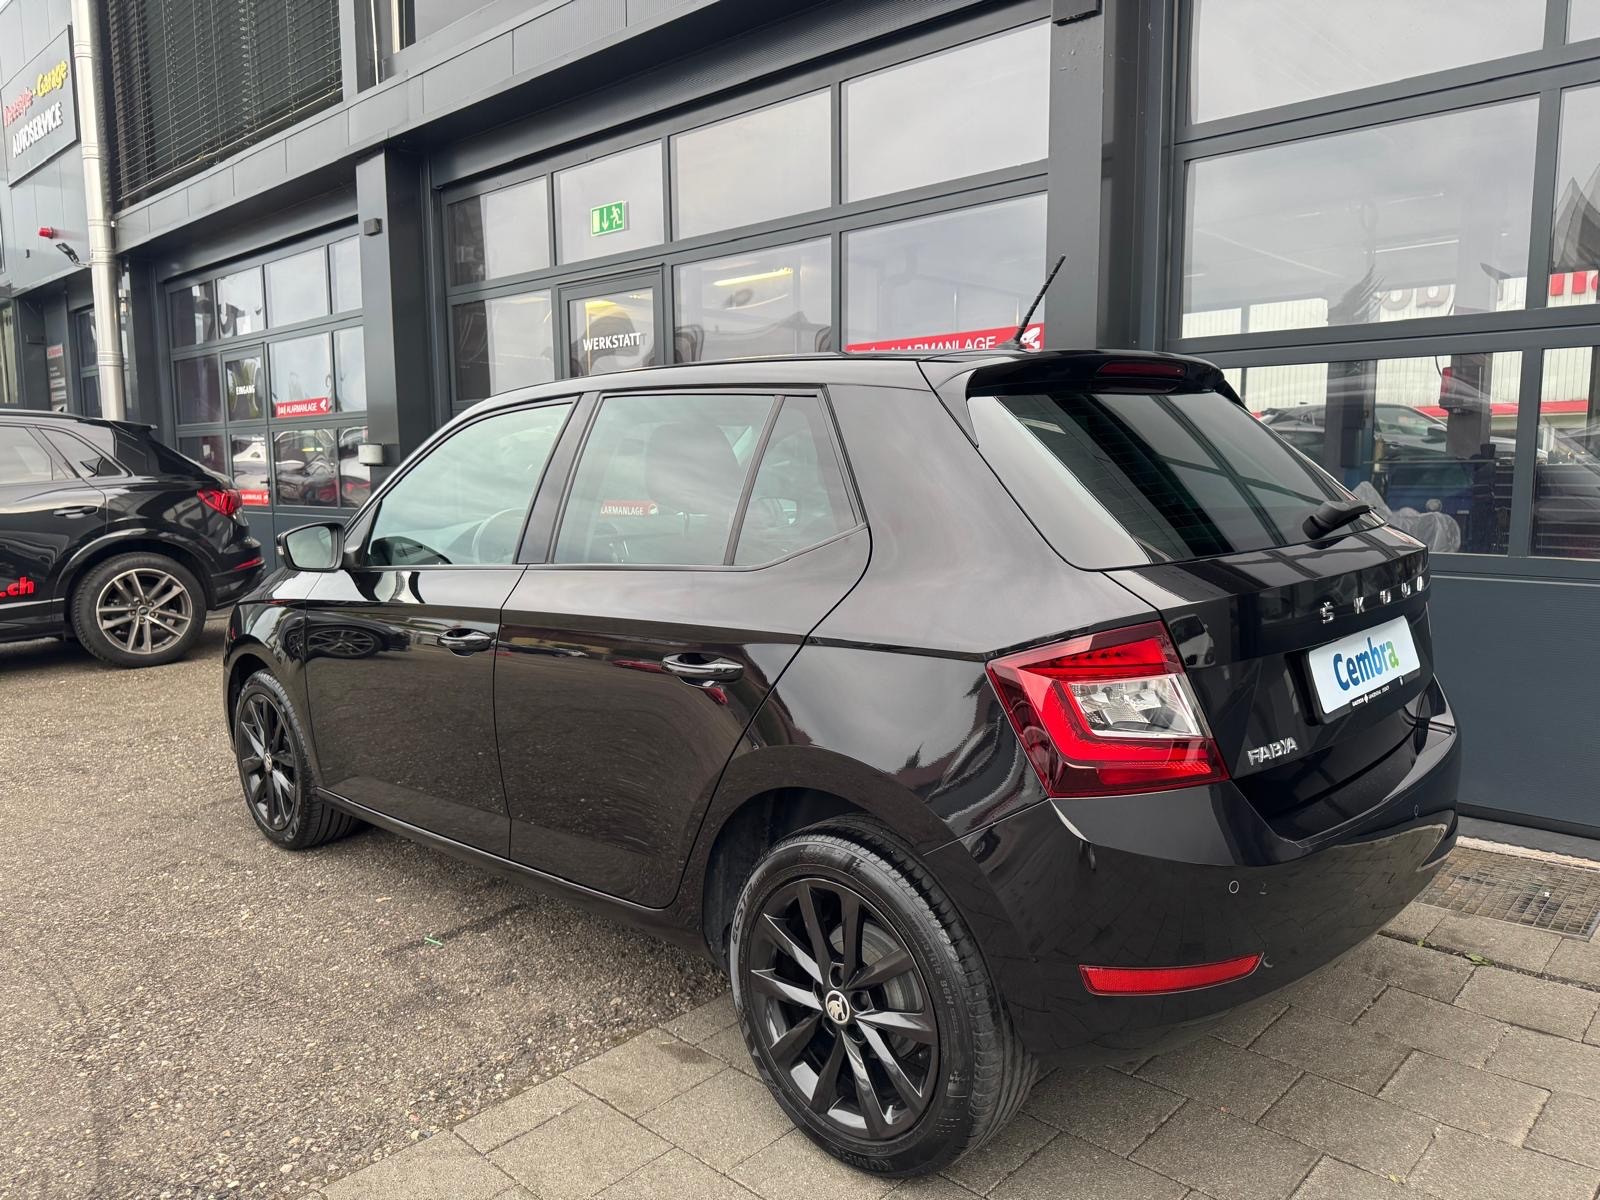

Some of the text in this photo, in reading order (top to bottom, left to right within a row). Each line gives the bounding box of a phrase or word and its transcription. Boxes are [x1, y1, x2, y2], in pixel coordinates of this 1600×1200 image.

[12, 101, 62, 158] AUTOSERVICE
[582, 332, 641, 351] WERKSTATT
[1333, 636, 1399, 691] Cembra
